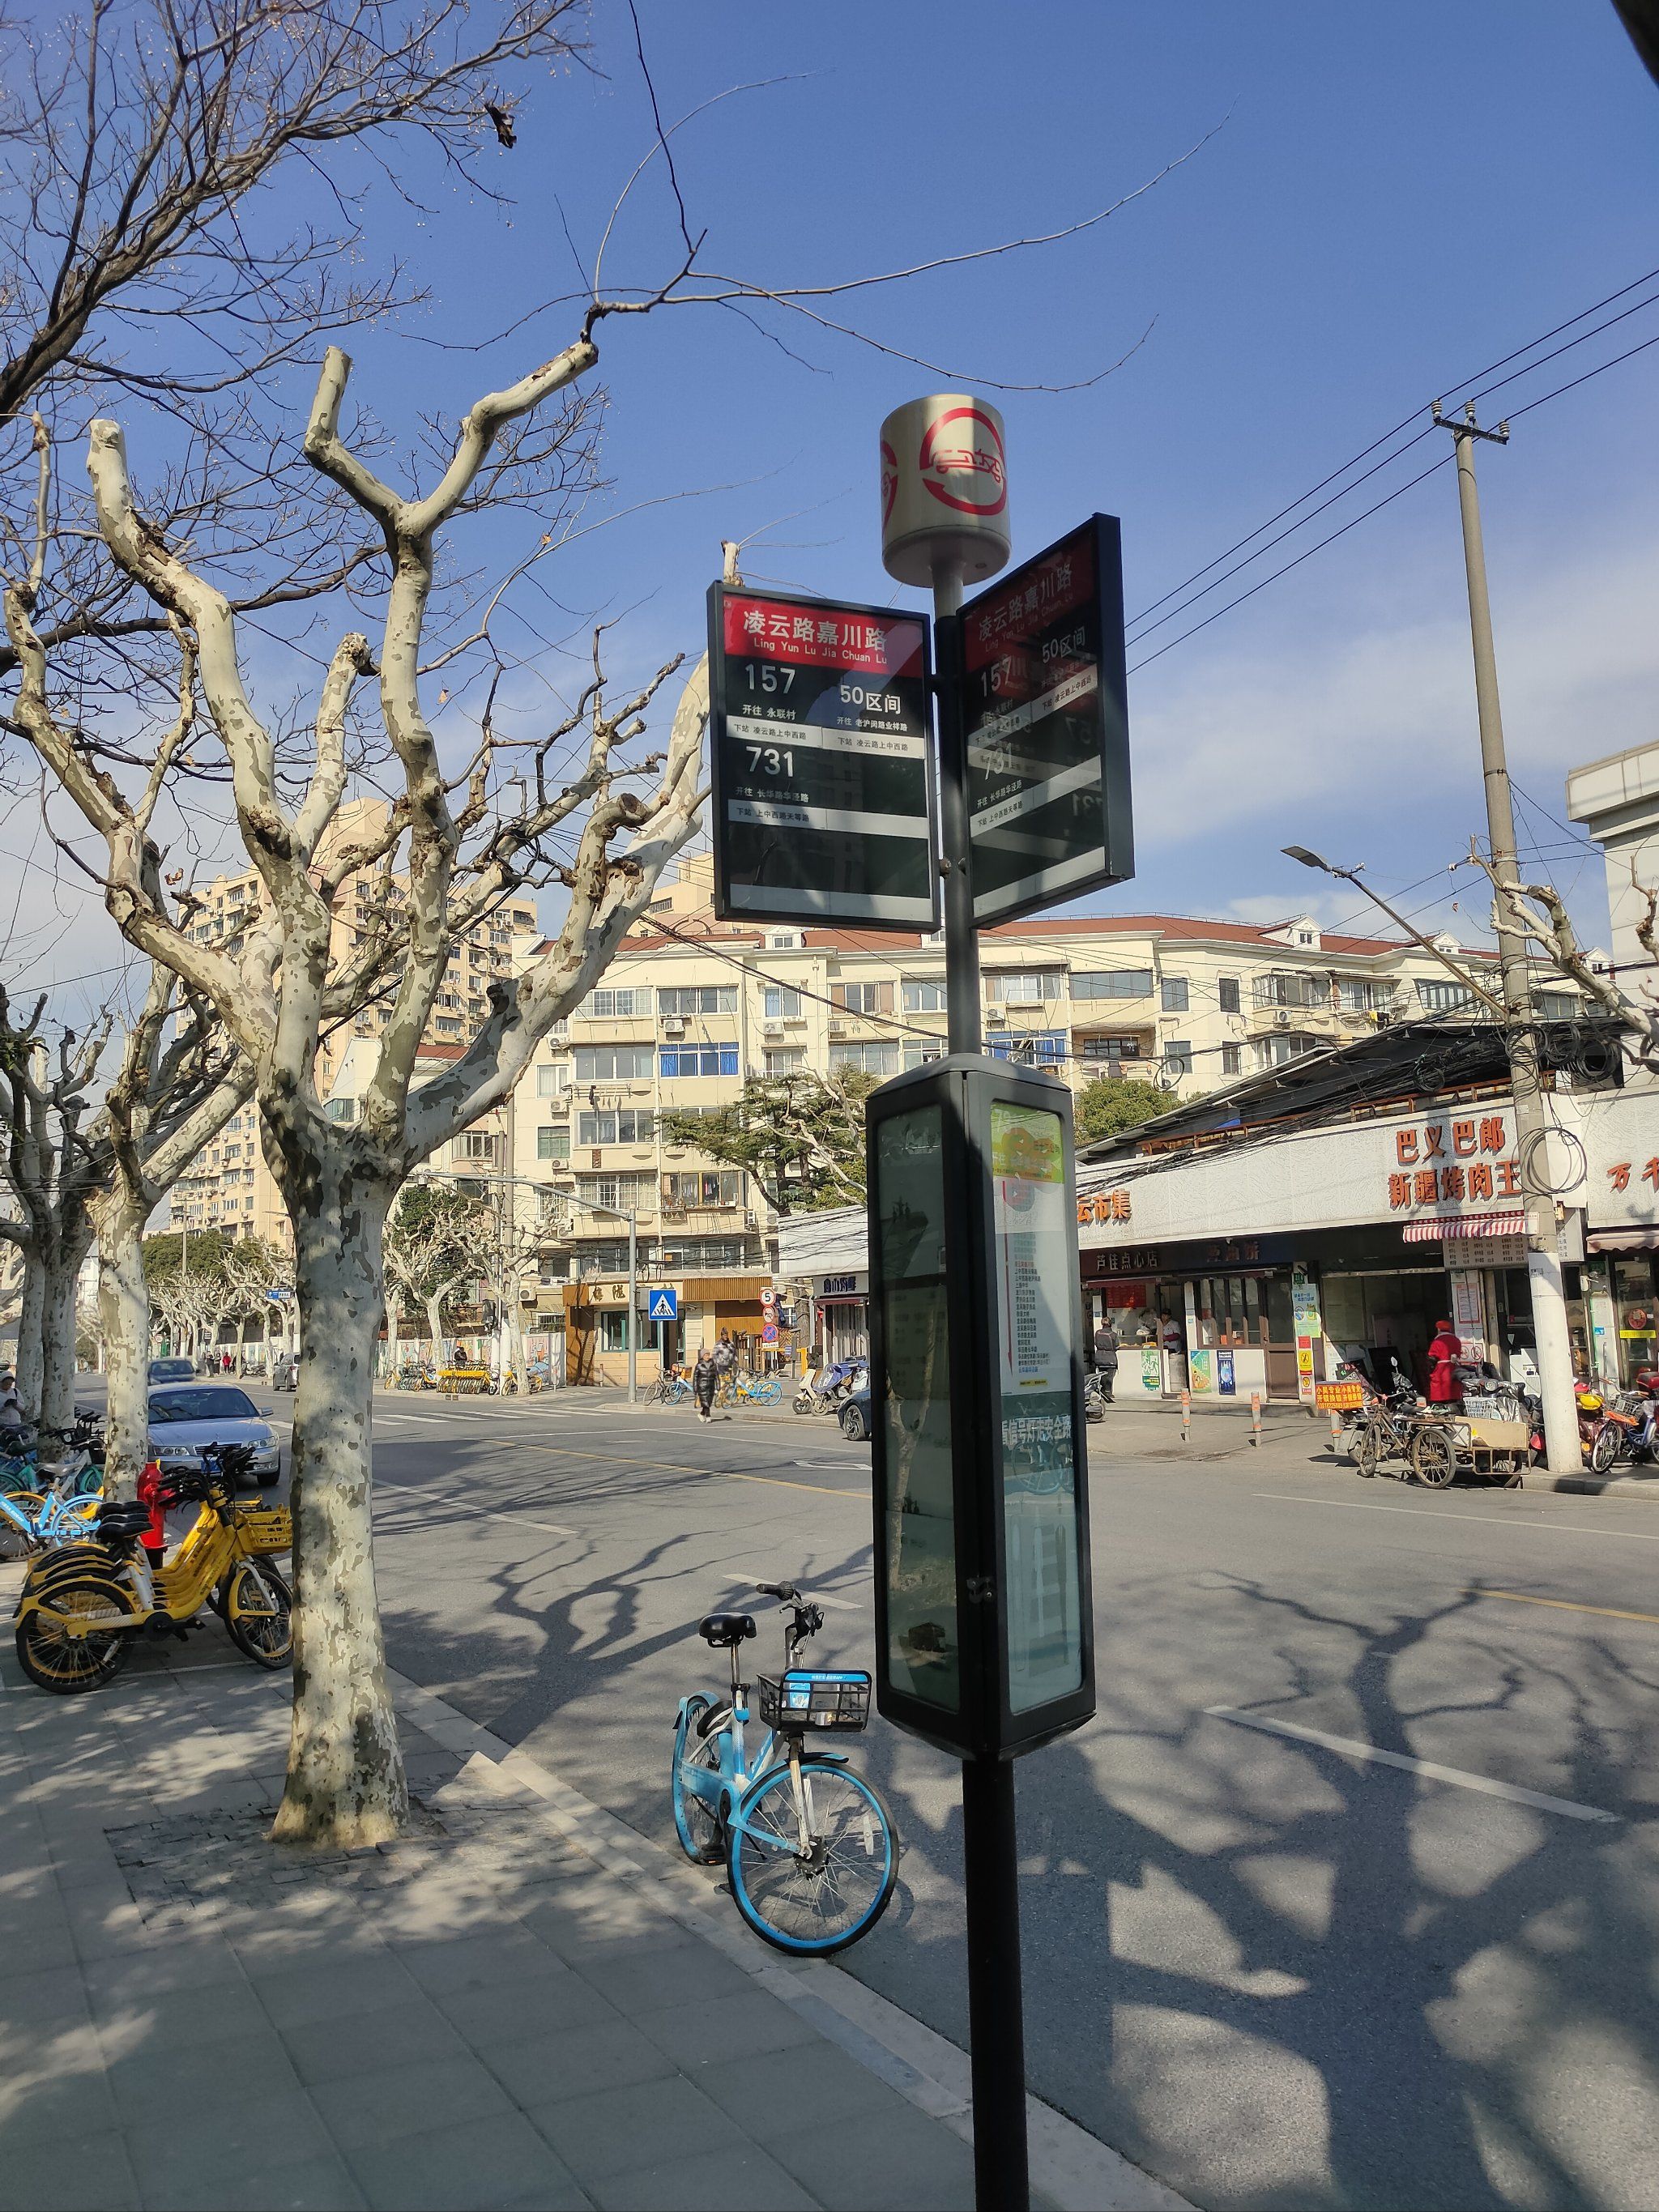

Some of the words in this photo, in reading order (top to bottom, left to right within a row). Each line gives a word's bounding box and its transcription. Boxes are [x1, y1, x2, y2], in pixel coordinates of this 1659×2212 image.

[979, 563, 1073, 641] 凌云路嘉川路
[743, 610, 887, 652] 凌云路嘉川路
[1042, 626, 1085, 664] 50区间
[754, 637, 775, 651] Ling
[781, 641, 800, 653] Yun
[804, 644, 817, 655] Lu
[821, 647, 837, 658] Jia
[842, 650, 871, 663] Chuan
[876, 654, 887, 664] Lu
[745, 663, 795, 694] 157
[981, 654, 1012, 697] 157
[742, 704, 762, 716] 开往
[766, 707, 796, 721] 永联村
[840, 684, 901, 715] 50区间
[734, 723, 749, 733] 下站
[753, 726, 807, 740] 凌云路上中西路
[836, 716, 852, 726] 开往
[838, 736, 853, 746] 下站
[856, 739, 908, 752] 凌云路上中西路
[746, 745, 793, 778] 731
[985, 742, 1013, 780] 731
[736, 786, 753, 797] 开往
[736, 807, 752, 816] 下站
[1396, 1117, 1507, 1164] 巴义巴郎
[1388, 1159, 1523, 1208] 新疆烤肉王
[765, 1292, 771, 1302] 5
